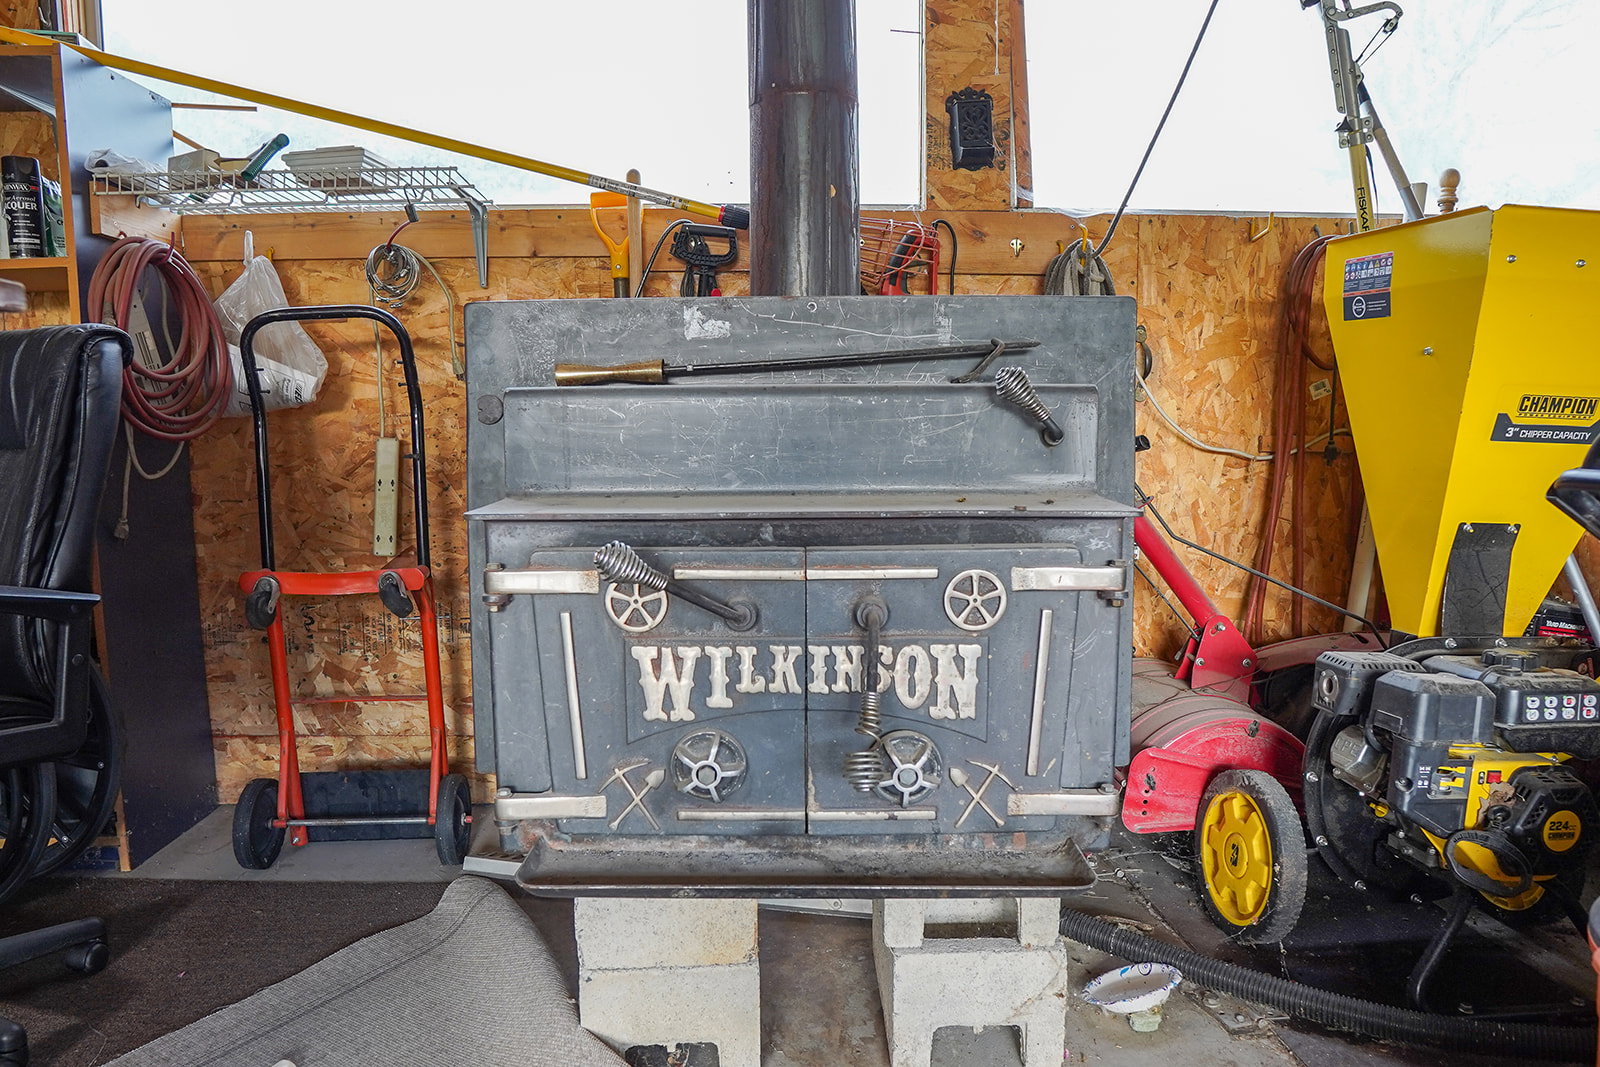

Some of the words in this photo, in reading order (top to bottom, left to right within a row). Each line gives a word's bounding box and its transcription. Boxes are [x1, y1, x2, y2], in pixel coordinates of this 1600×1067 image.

[1518, 396, 1598, 415] CHAMPION
[1519, 429, 1552, 439] CHIPPER
[1552, 431, 1592, 441] CAPACITY
[631, 644, 982, 722] WILKINSON
